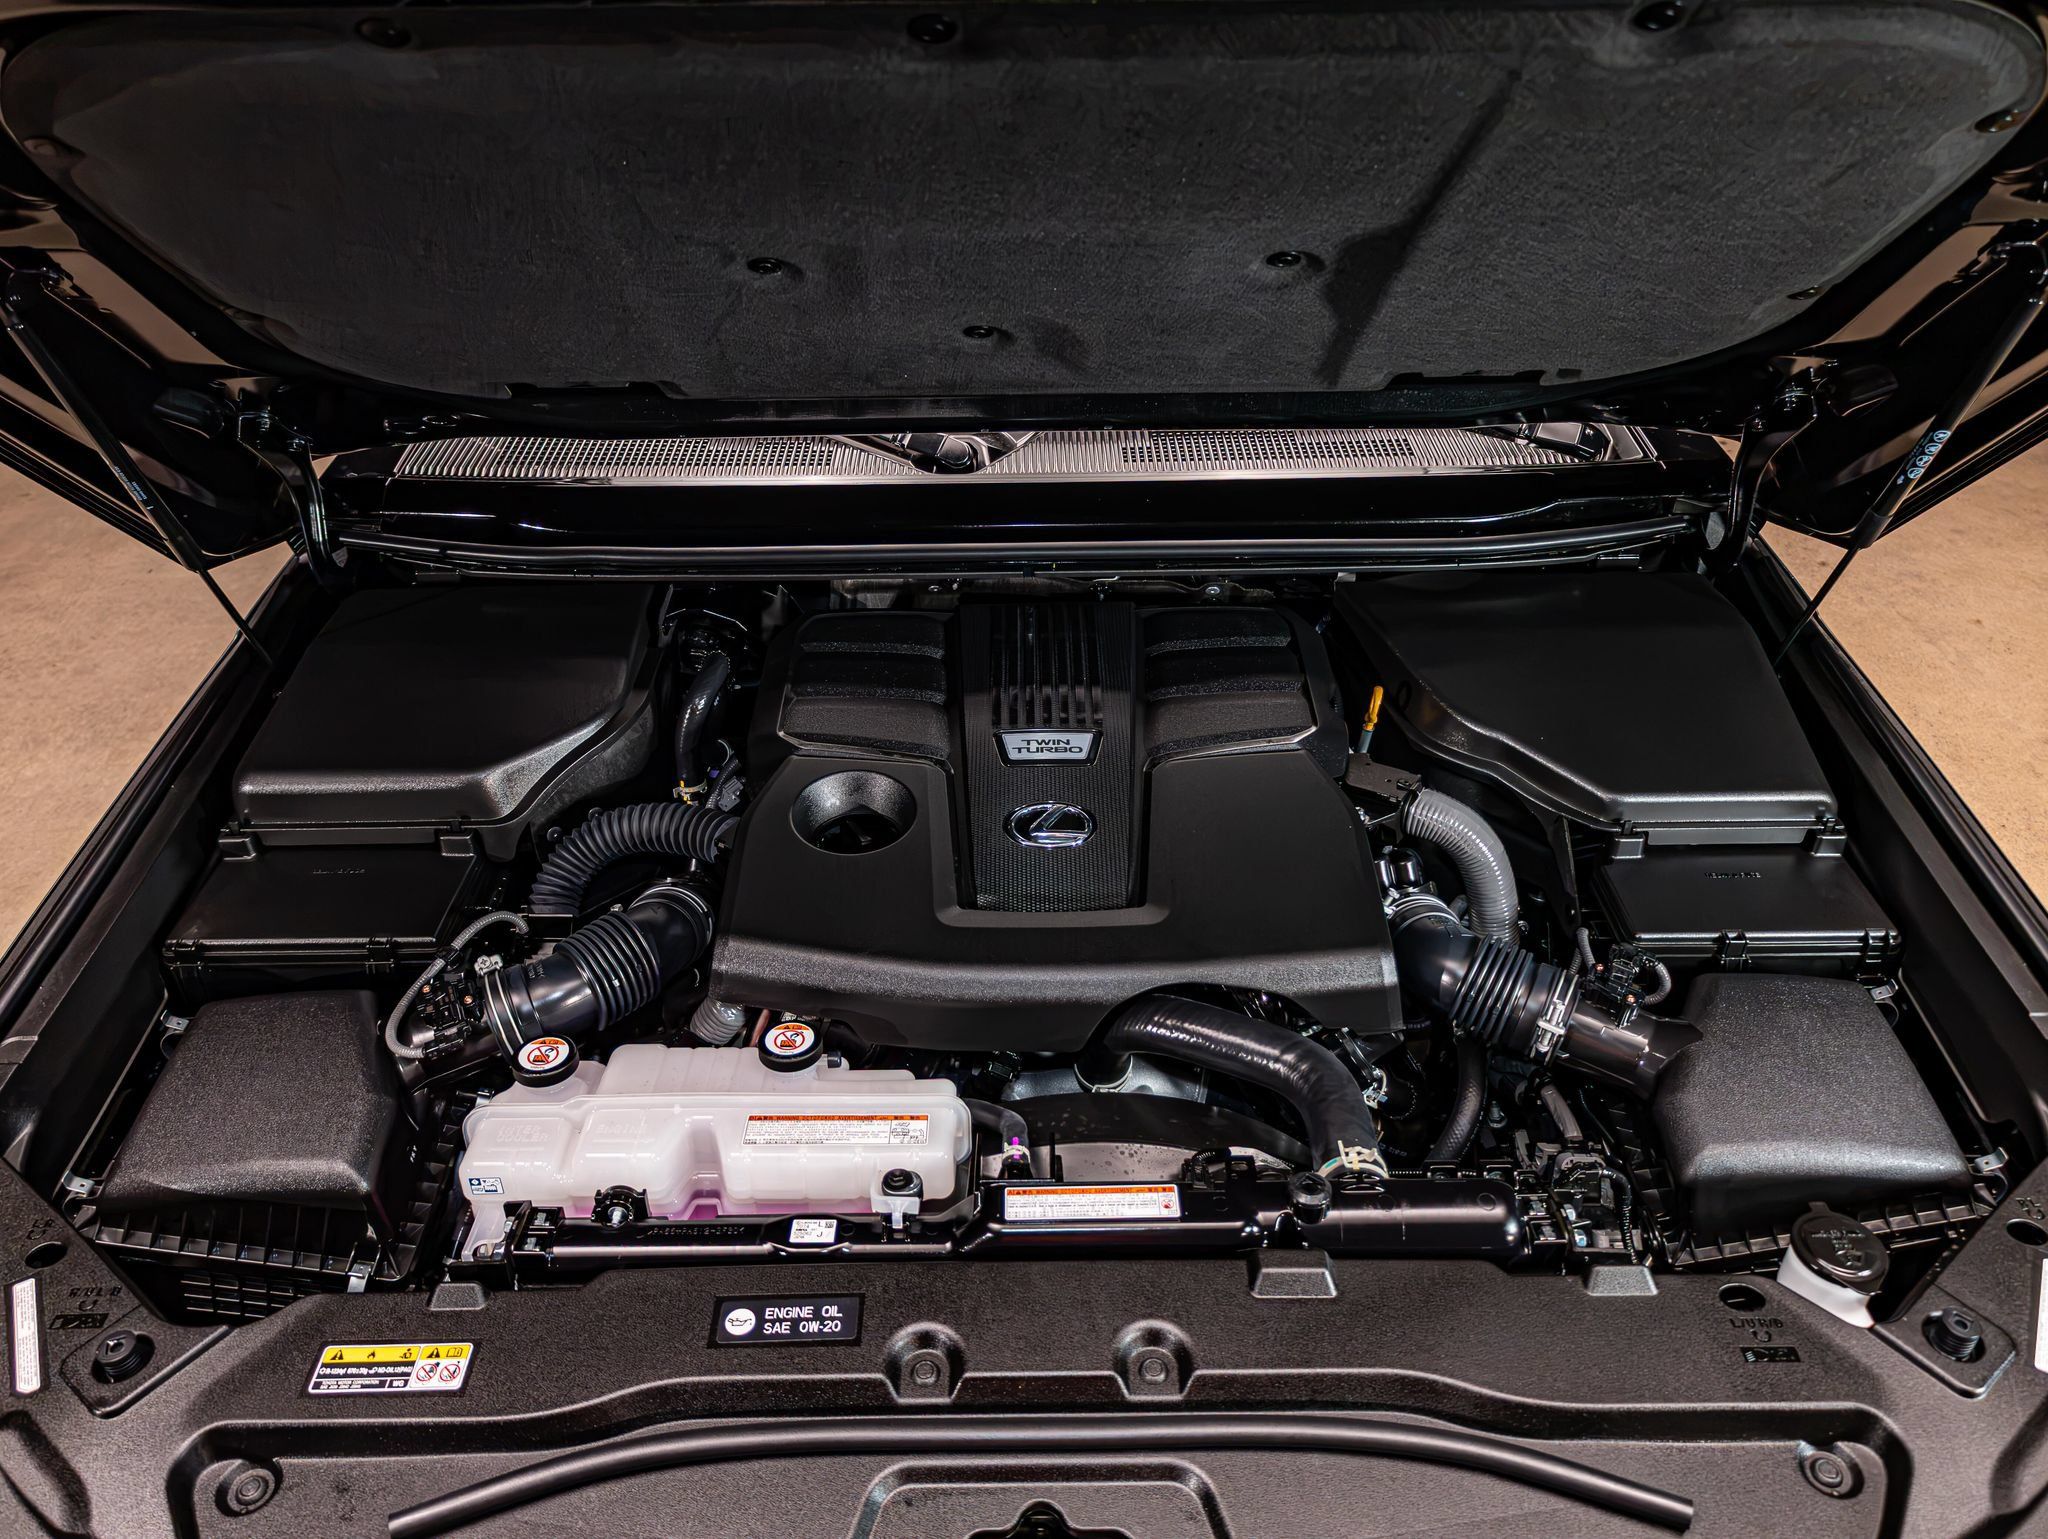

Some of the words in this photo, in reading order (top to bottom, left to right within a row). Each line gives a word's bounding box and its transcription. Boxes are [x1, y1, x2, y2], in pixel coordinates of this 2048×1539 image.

[764, 1306, 814, 1319] ENGINE
[821, 1305, 843, 1317] OIL
[763, 1322, 791, 1334] SAE
[799, 1320, 841, 1333] 0W-20
